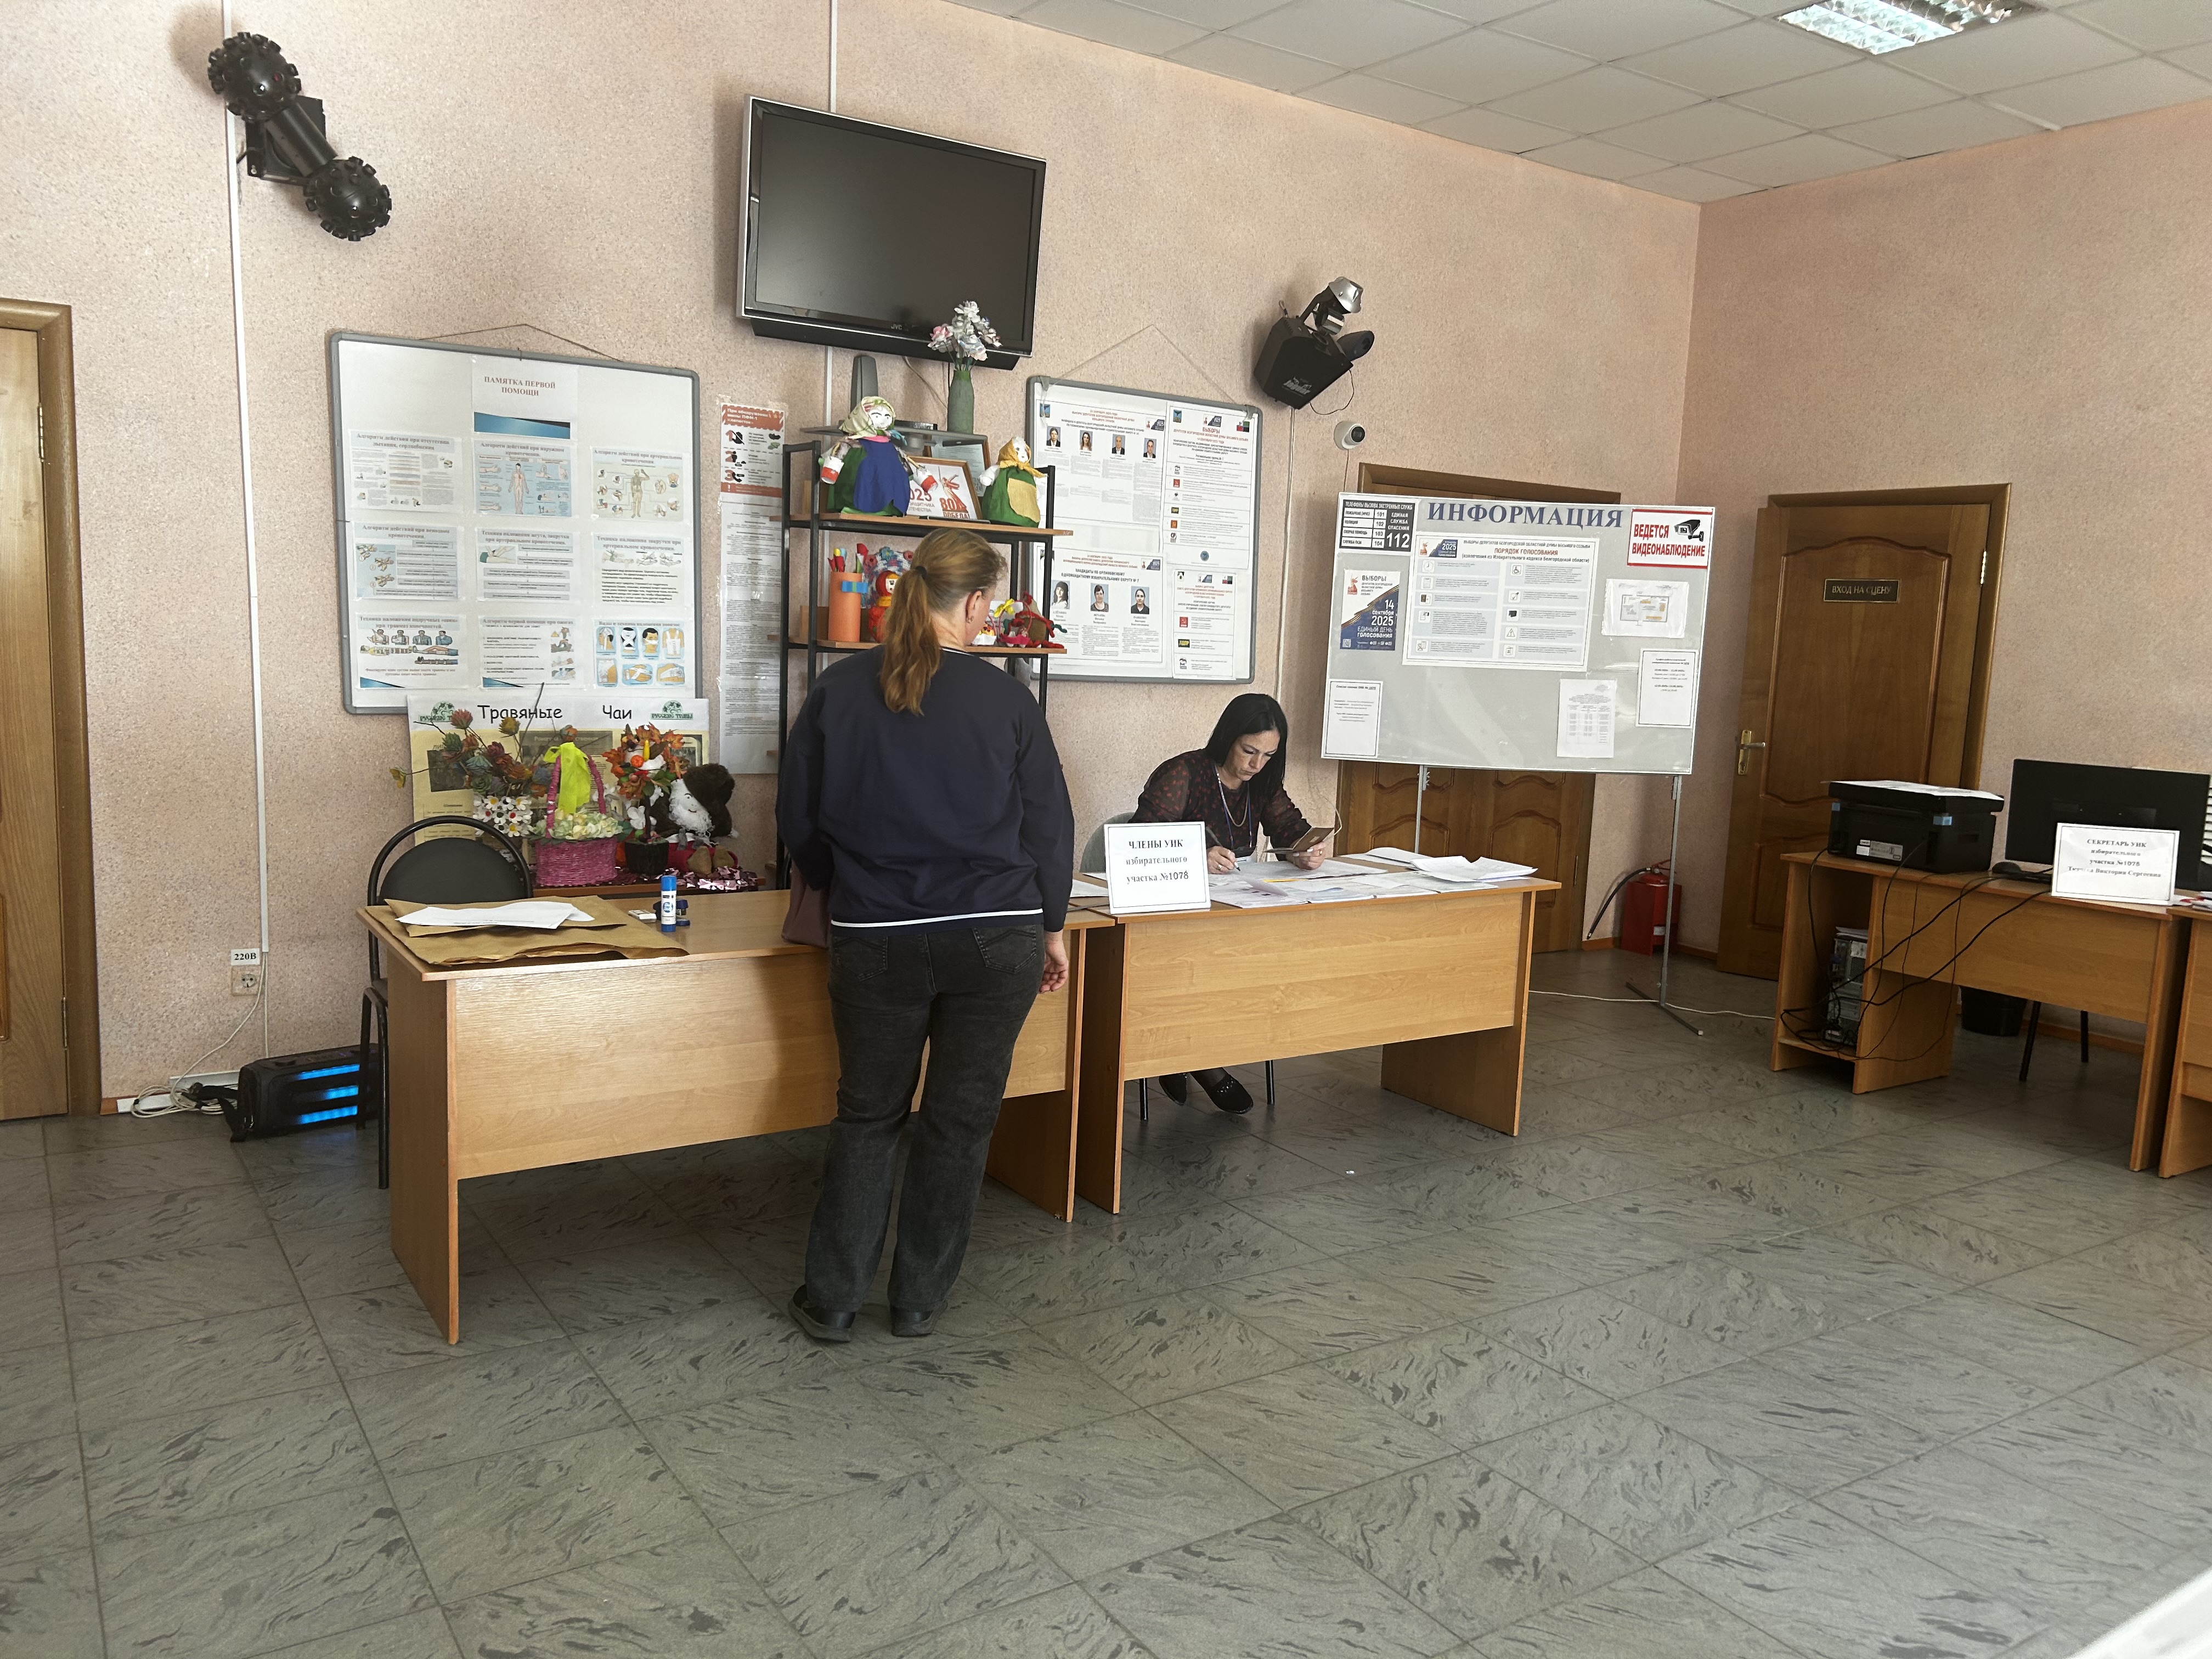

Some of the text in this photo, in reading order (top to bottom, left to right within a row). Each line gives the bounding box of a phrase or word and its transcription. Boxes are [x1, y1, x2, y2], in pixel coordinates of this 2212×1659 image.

[484, 376, 556, 389] ПАМЯТКА ПЕРВОЙ
[501, 387, 539, 397] ПОМОЩИ
[1427, 502, 1623, 531] ИНФОРМАЦИЯ
[1633, 523, 1669, 539] ВЕДЕТСЯ
[1386, 532, 1410, 548] 112
[1632, 541, 1706, 558] ВИДЕОНАБЛЮДЕНИЕ
[1832, 585, 1892, 595] ВХОД НА СЦЕНУ
[1385, 599, 1394, 610] 14
[1371, 616, 1393, 626] 2025
[477, 704, 633, 724] Травяные Чаи
[1128, 839, 1183, 849] ЧЛЕНЫ УИК
[1126, 856, 1187, 867] избирательного
[1126, 870, 1189, 885] участка №1078
[234, 952, 256, 961] 220В
